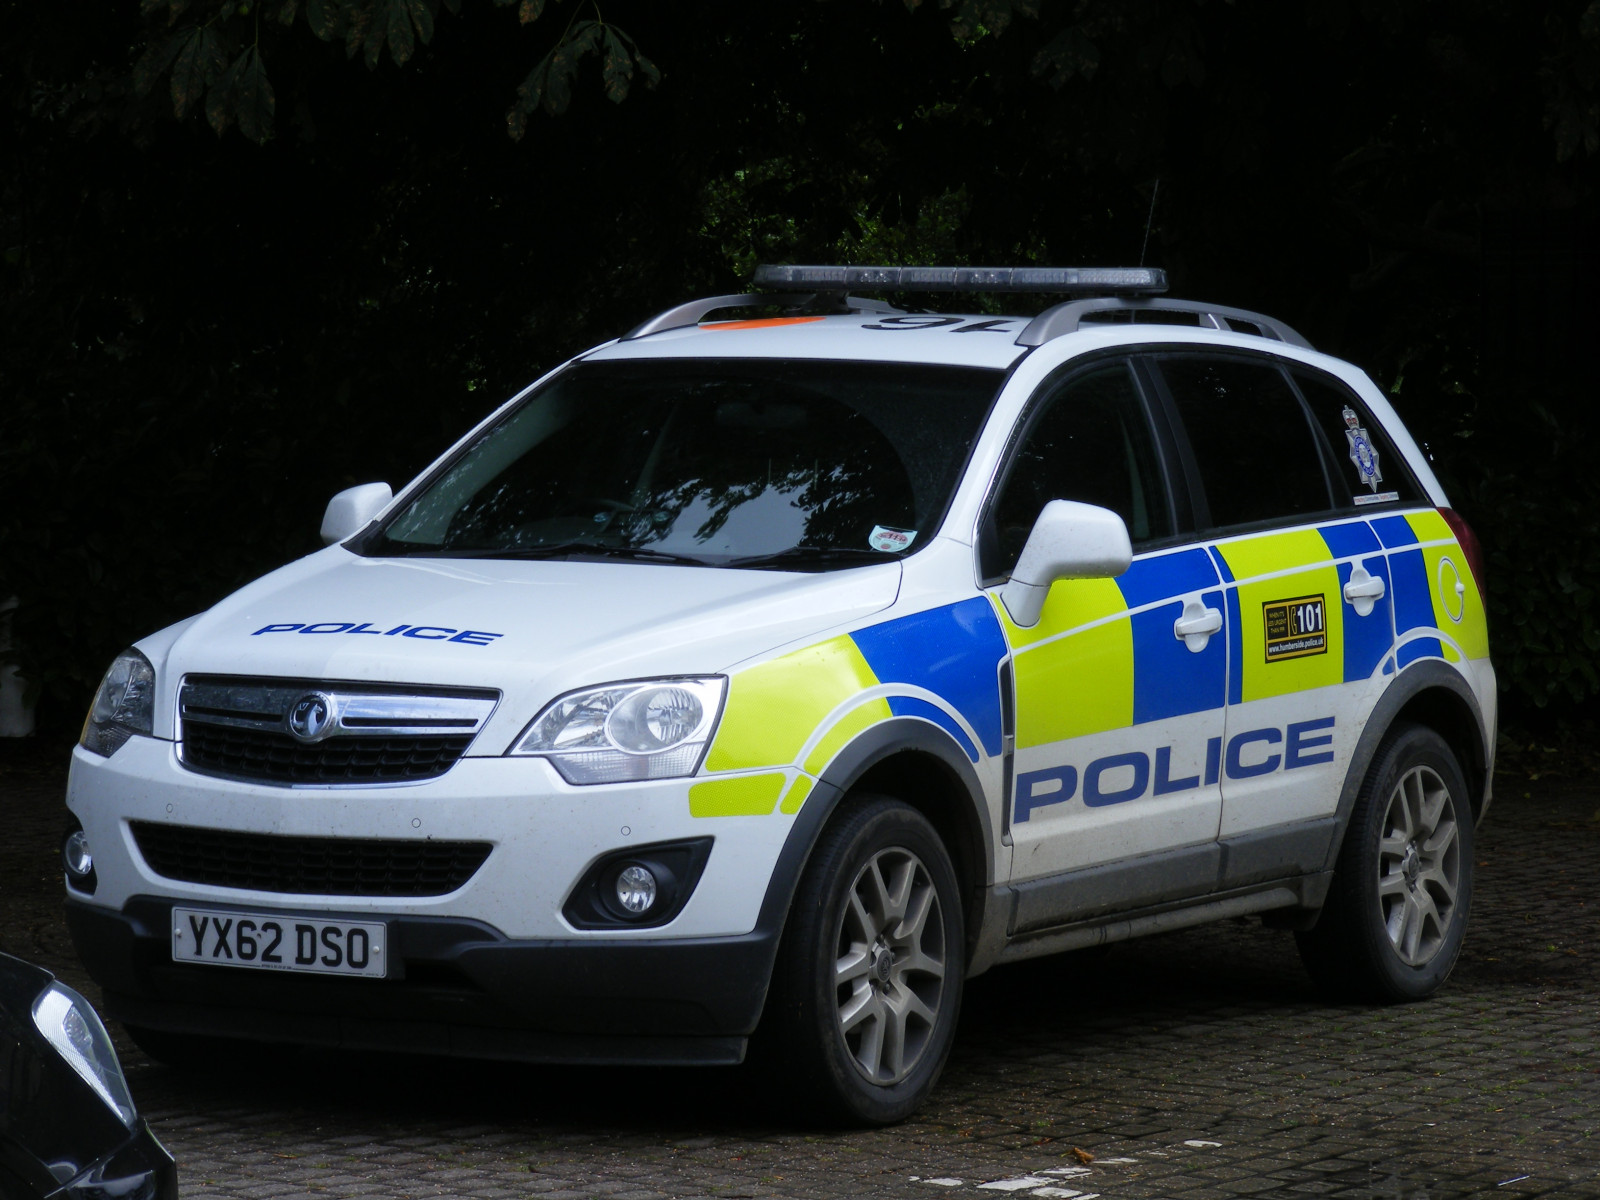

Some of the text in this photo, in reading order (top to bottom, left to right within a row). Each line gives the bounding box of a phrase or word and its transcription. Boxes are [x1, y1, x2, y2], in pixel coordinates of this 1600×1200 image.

[1297, 603, 1323, 633] 101
[251, 623, 504, 646] POLICE
[1268, 637, 1323, 653] www.humberside.police.uk
[1013, 716, 1336, 824] POLICE
[189, 915, 369, 969] YX62 DSO
